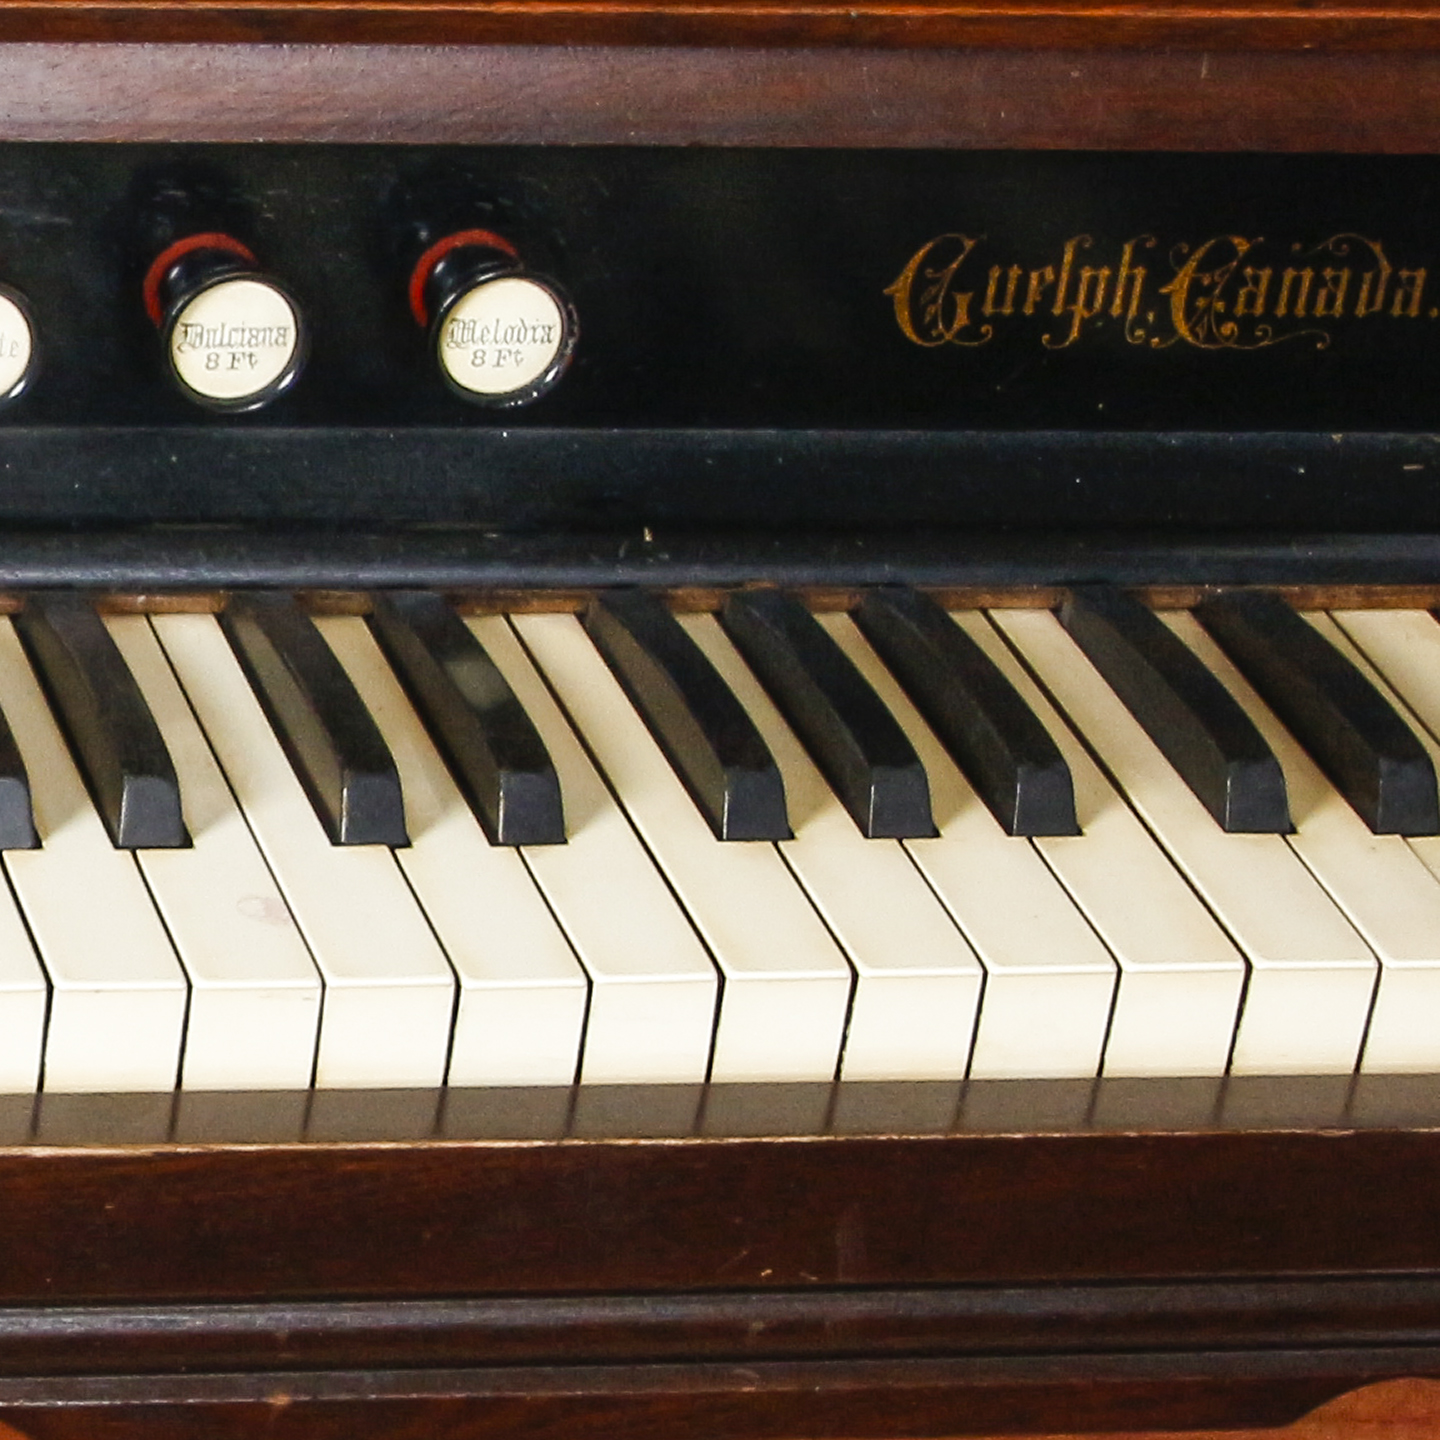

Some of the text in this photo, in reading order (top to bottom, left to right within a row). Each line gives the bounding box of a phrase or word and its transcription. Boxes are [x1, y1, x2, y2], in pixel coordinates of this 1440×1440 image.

[176, 321, 291, 354] Dulciana
[445, 317, 557, 349] Melodia
[204, 351, 258, 371] 8 Ft
[470, 348, 525, 368] 8 Ft
